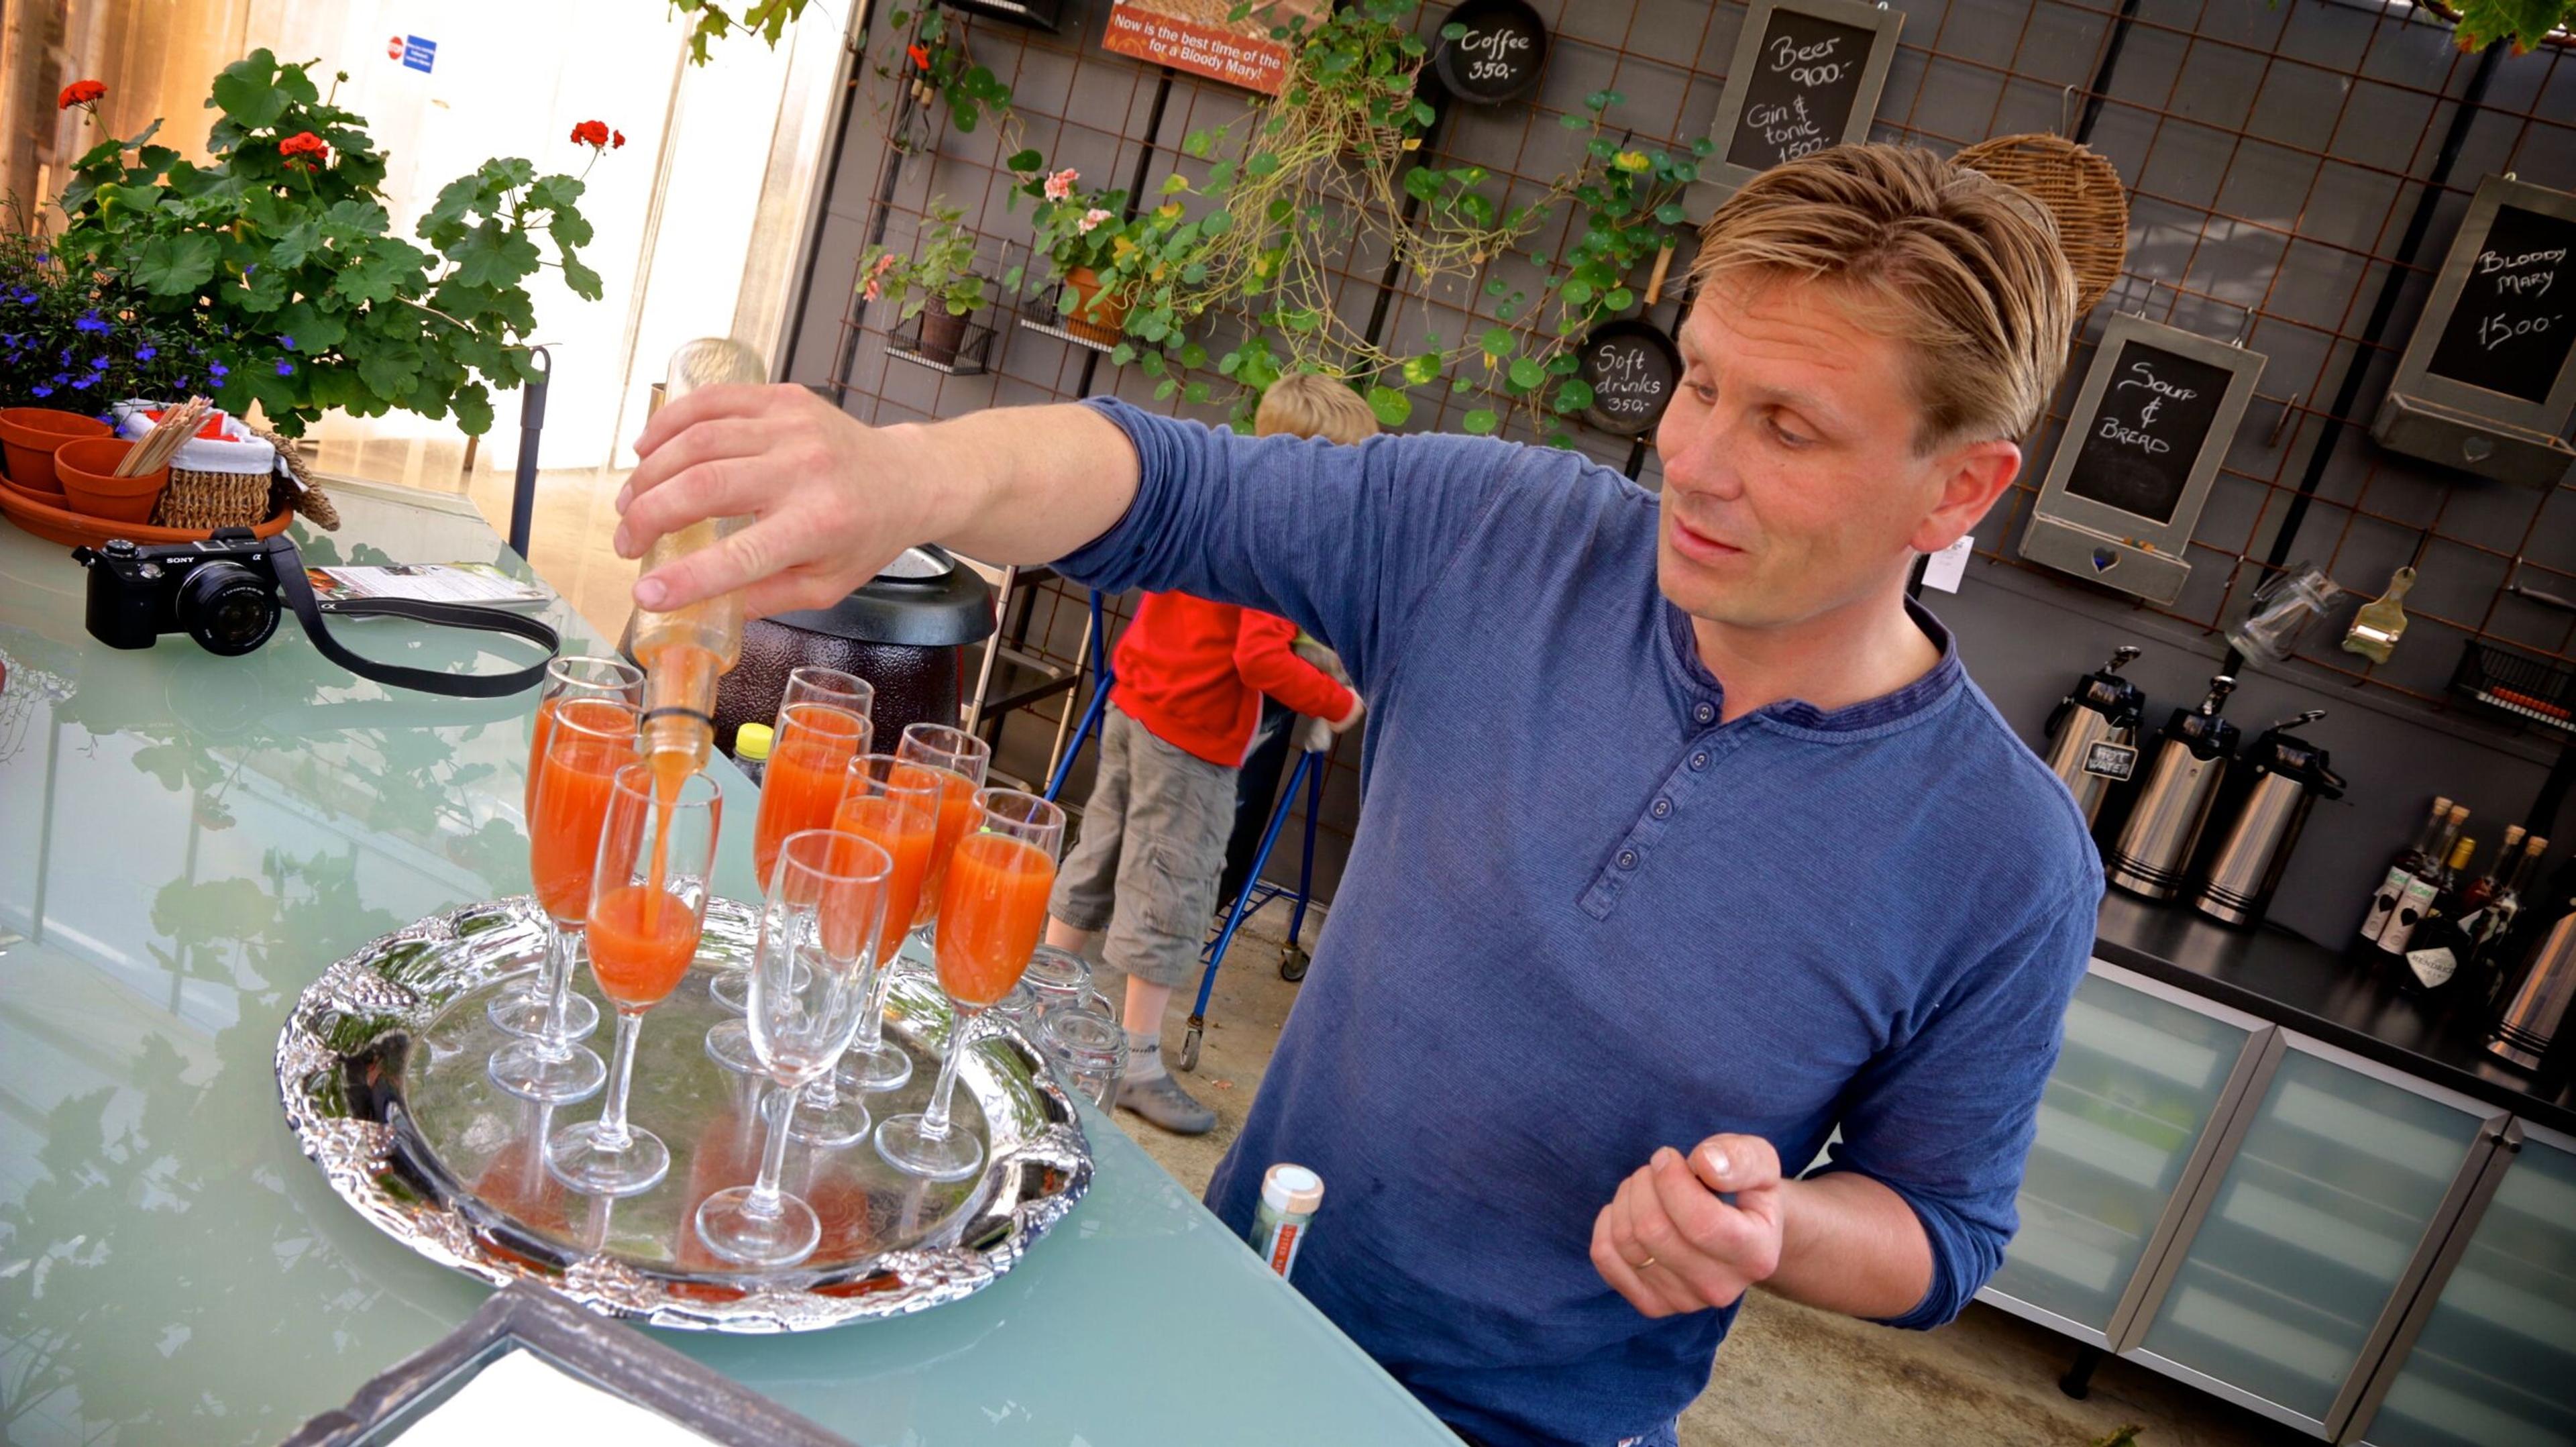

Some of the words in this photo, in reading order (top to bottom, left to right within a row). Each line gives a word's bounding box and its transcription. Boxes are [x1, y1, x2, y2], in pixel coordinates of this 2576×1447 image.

[1114, 13, 1142, 32] Now
[1144, 21, 1155, 36] is
[1158, 25, 1179, 42] the
[1181, 32, 1209, 50] best
[1211, 40, 1239, 58] time
[1243, 50, 1258, 62] of
[1259, 53, 1281, 68] the
[1461, 28, 1529, 60] Coffee
[1770, 36, 1841, 72] Beer
[1149, 38, 1167, 54] for
[1169, 47, 1178, 57] a
[1181, 47, 1223, 71] Bloody
[1226, 59, 1263, 80] Mary!
[1747, 103, 1788, 127] Gin
[1793, 94, 1809, 121] &
[1765, 121, 1820, 144] tonic
[1597, 345, 1645, 380] Soft
[1595, 373, 1660, 394] drinks
[2088, 758, 2129, 774] WATER
[2096, 747, 2131, 763] HOT
